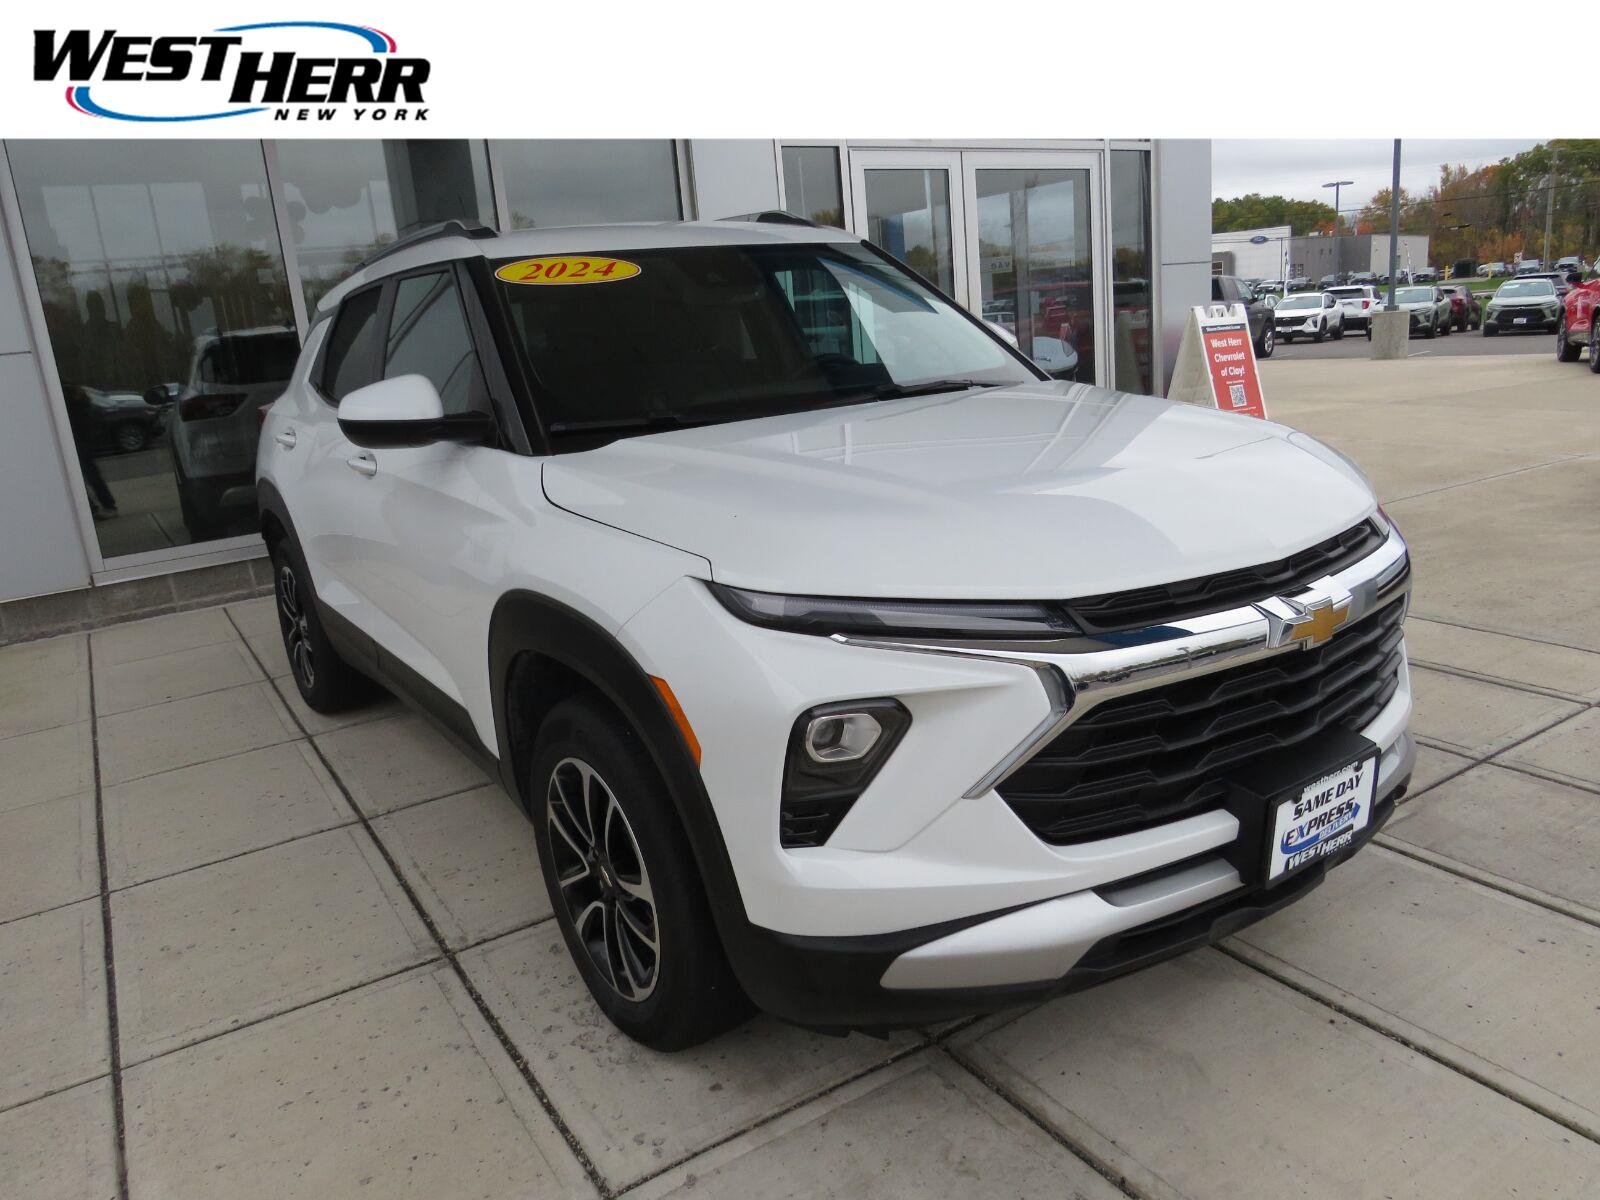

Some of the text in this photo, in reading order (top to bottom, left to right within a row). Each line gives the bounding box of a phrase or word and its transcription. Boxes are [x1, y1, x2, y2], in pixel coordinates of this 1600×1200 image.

[519, 261, 617, 281] 2024
[1210, 337, 1242, 348] West Herr
[1214, 351, 1245, 362] Chevrolet
[1220, 365, 1245, 377] of Clay!
[1293, 771, 1364, 821] SAME DAY
[1286, 797, 1355, 847] EXPRESS
